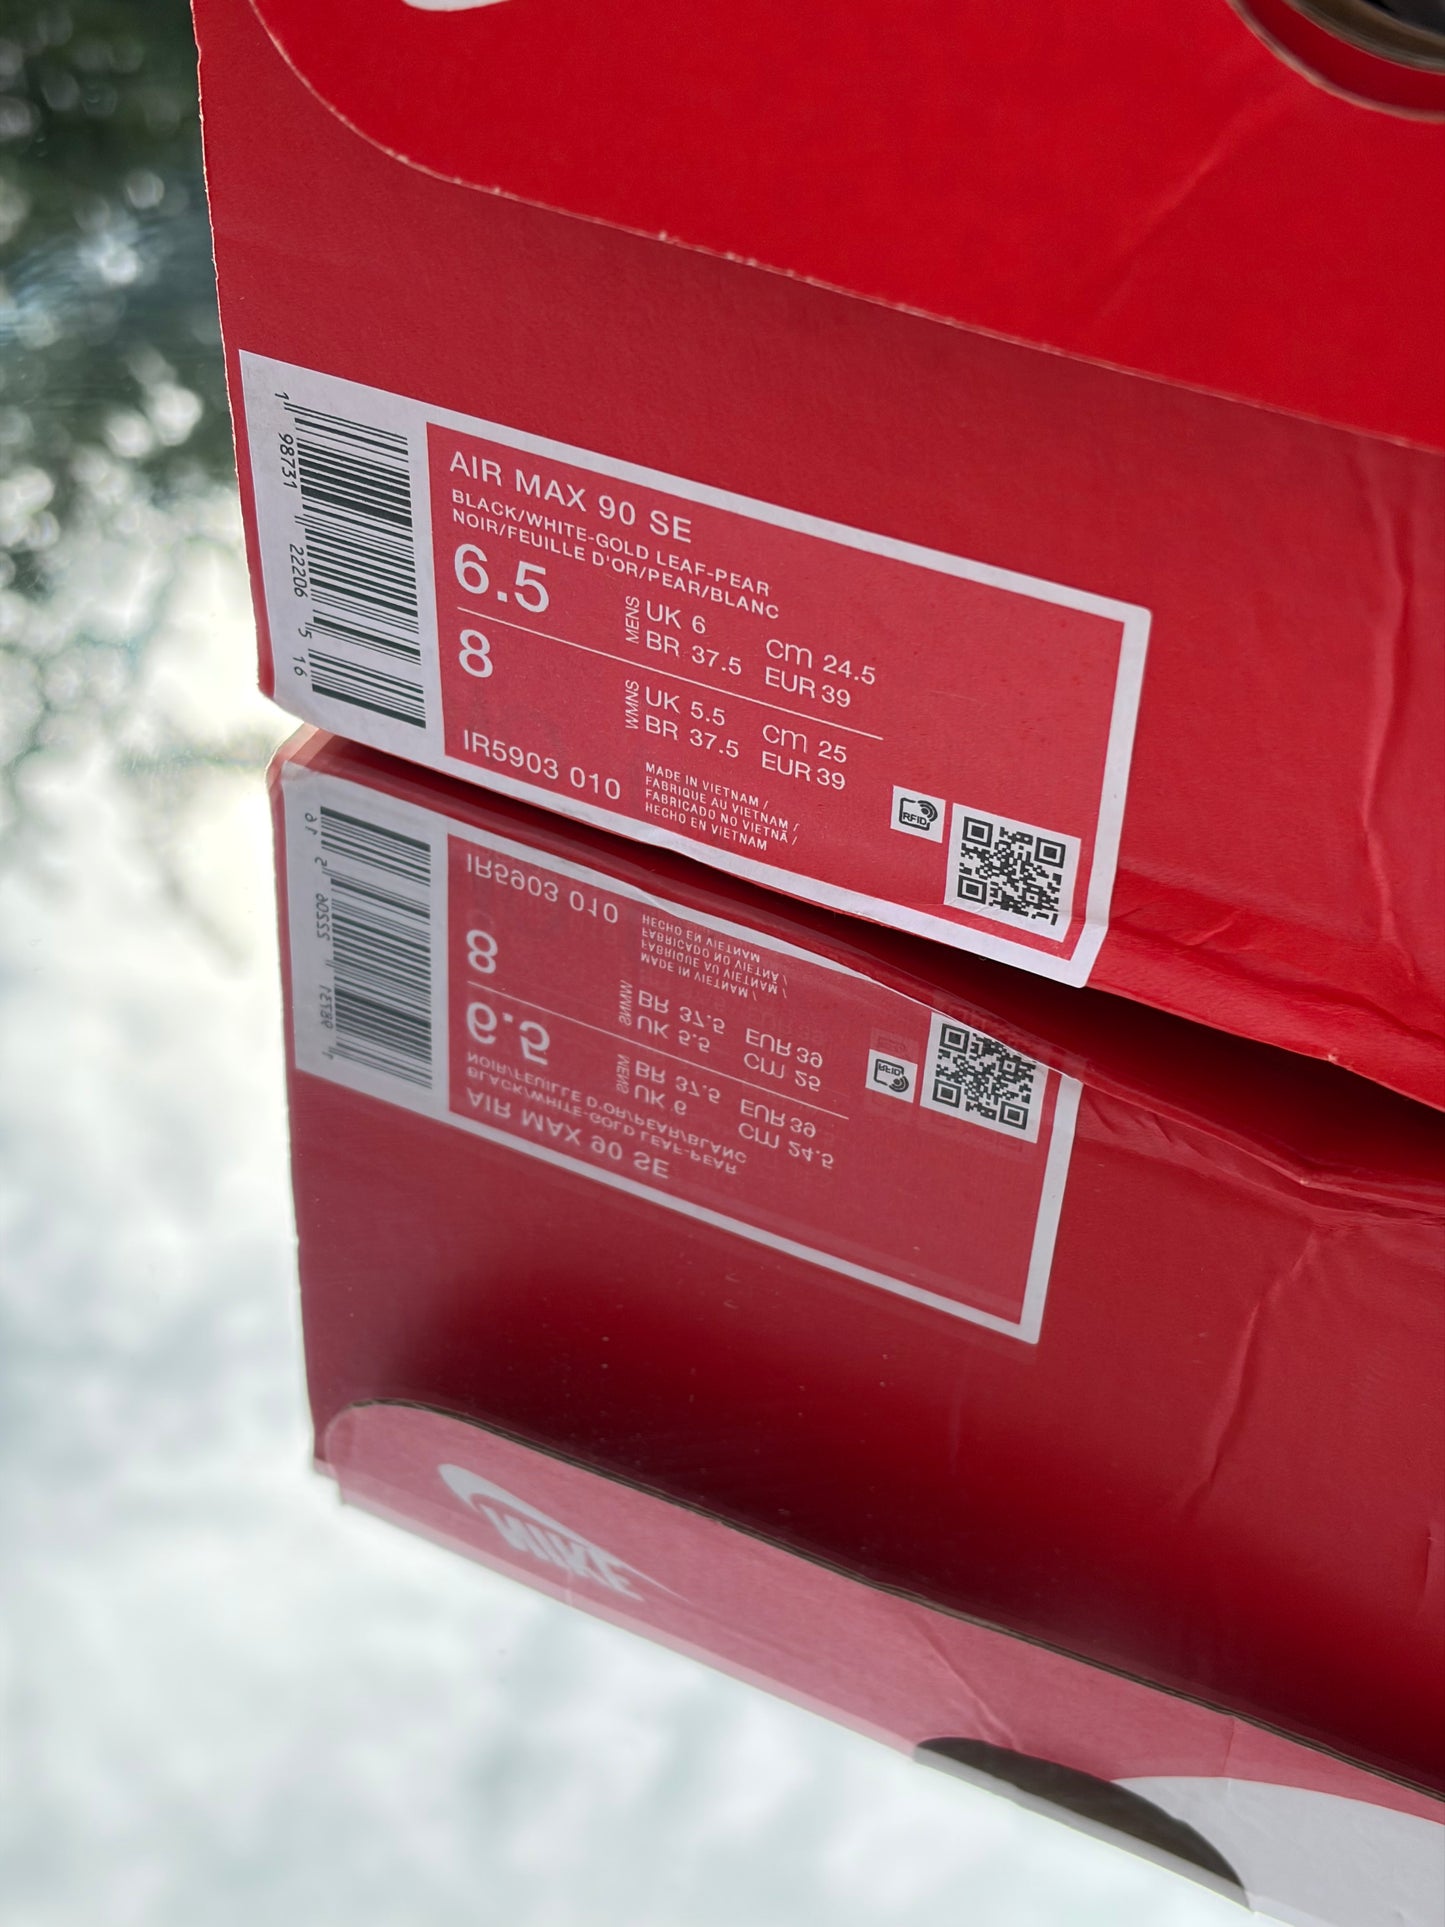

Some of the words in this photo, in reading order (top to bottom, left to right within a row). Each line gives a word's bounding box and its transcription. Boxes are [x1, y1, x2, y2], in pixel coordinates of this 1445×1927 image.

[275, 392, 290, 401] 1
[278, 432, 297, 489] 98731
[450, 451, 502, 487] AIR
[516, 470, 587, 512] MAX
[599, 495, 636, 526] 90
[650, 510, 693, 543] SE
[452, 489, 649, 558] BLACK/WHITE-GOLD
[656, 550, 770, 597] LEAF-PEAR
[453, 508, 586, 561] NOIR/FEUILLE
[592, 551, 779, 619] D'OR/PEAR/BLANC
[289, 544, 308, 598] 22206
[454, 543, 550, 613] 6.5
[298, 628, 313, 638] 5
[625, 596, 640, 644] MENS
[646, 600, 682, 630] UK
[691, 615, 706, 635] 6
[295, 656, 307, 676] 16
[458, 629, 494, 678] 8
[646, 630, 680, 657] BR
[691, 645, 742, 676] 37.5
[823, 654, 876, 685] 24.5
[625, 680, 639, 729] WMNS
[646, 686, 680, 714] UK
[690, 701, 726, 726] 5.5
[765, 667, 816, 699] EUR
[821, 684, 850, 708] 39
[646, 715, 678, 741] BR
[689, 729, 739, 758] 37.5
[818, 740, 847, 763] 25
[463, 730, 559, 780] IR5903
[570, 767, 620, 799] 010
[646, 762, 680, 781] MADE
[685, 775, 698, 787] IN
[702, 780, 758, 807] VIETNAM
[762, 751, 811, 783] EUR
[817, 769, 845, 790] 39
[646, 776, 706, 803] FABRIQUE
[711, 798, 727, 810] AU
[731, 803, 789, 829] VIETNAM
[646, 789, 716, 820] FABRICADO
[721, 813, 738, 827] NO
[742, 820, 788, 843] VIETNÃ
[902, 812, 927, 825] RFID
[646, 802, 685, 824] HECHO
[691, 817, 707, 831] EN
[711, 823, 767, 851] VIETNAM
